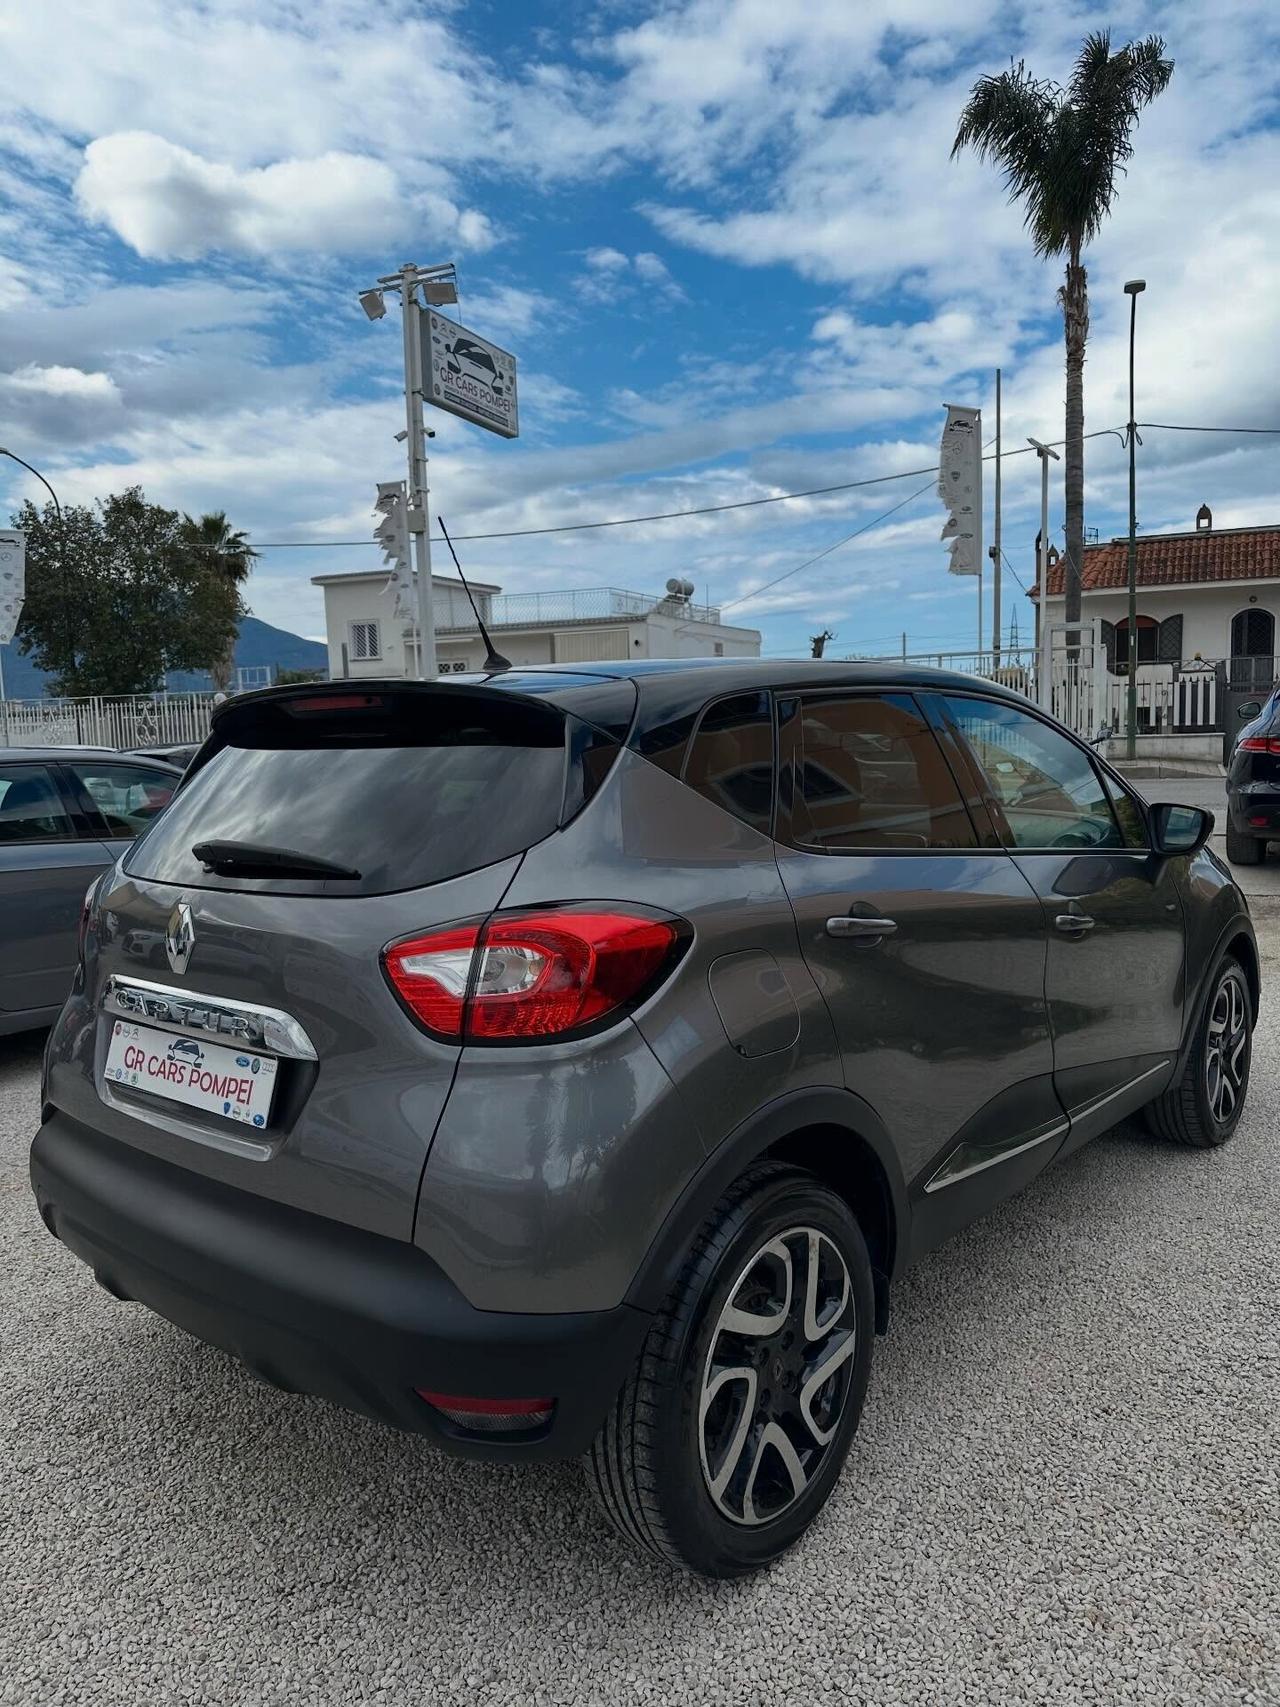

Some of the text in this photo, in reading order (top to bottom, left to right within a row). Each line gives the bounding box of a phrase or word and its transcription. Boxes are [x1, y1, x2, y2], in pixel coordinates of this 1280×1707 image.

[440, 367, 454, 385] GR
[456, 377, 478, 396] CARS
[480, 388, 510, 413] POMPEI
[115, 989, 250, 1039] CAPTUR
[124, 1045, 254, 1105] GR CARS POMPEI
